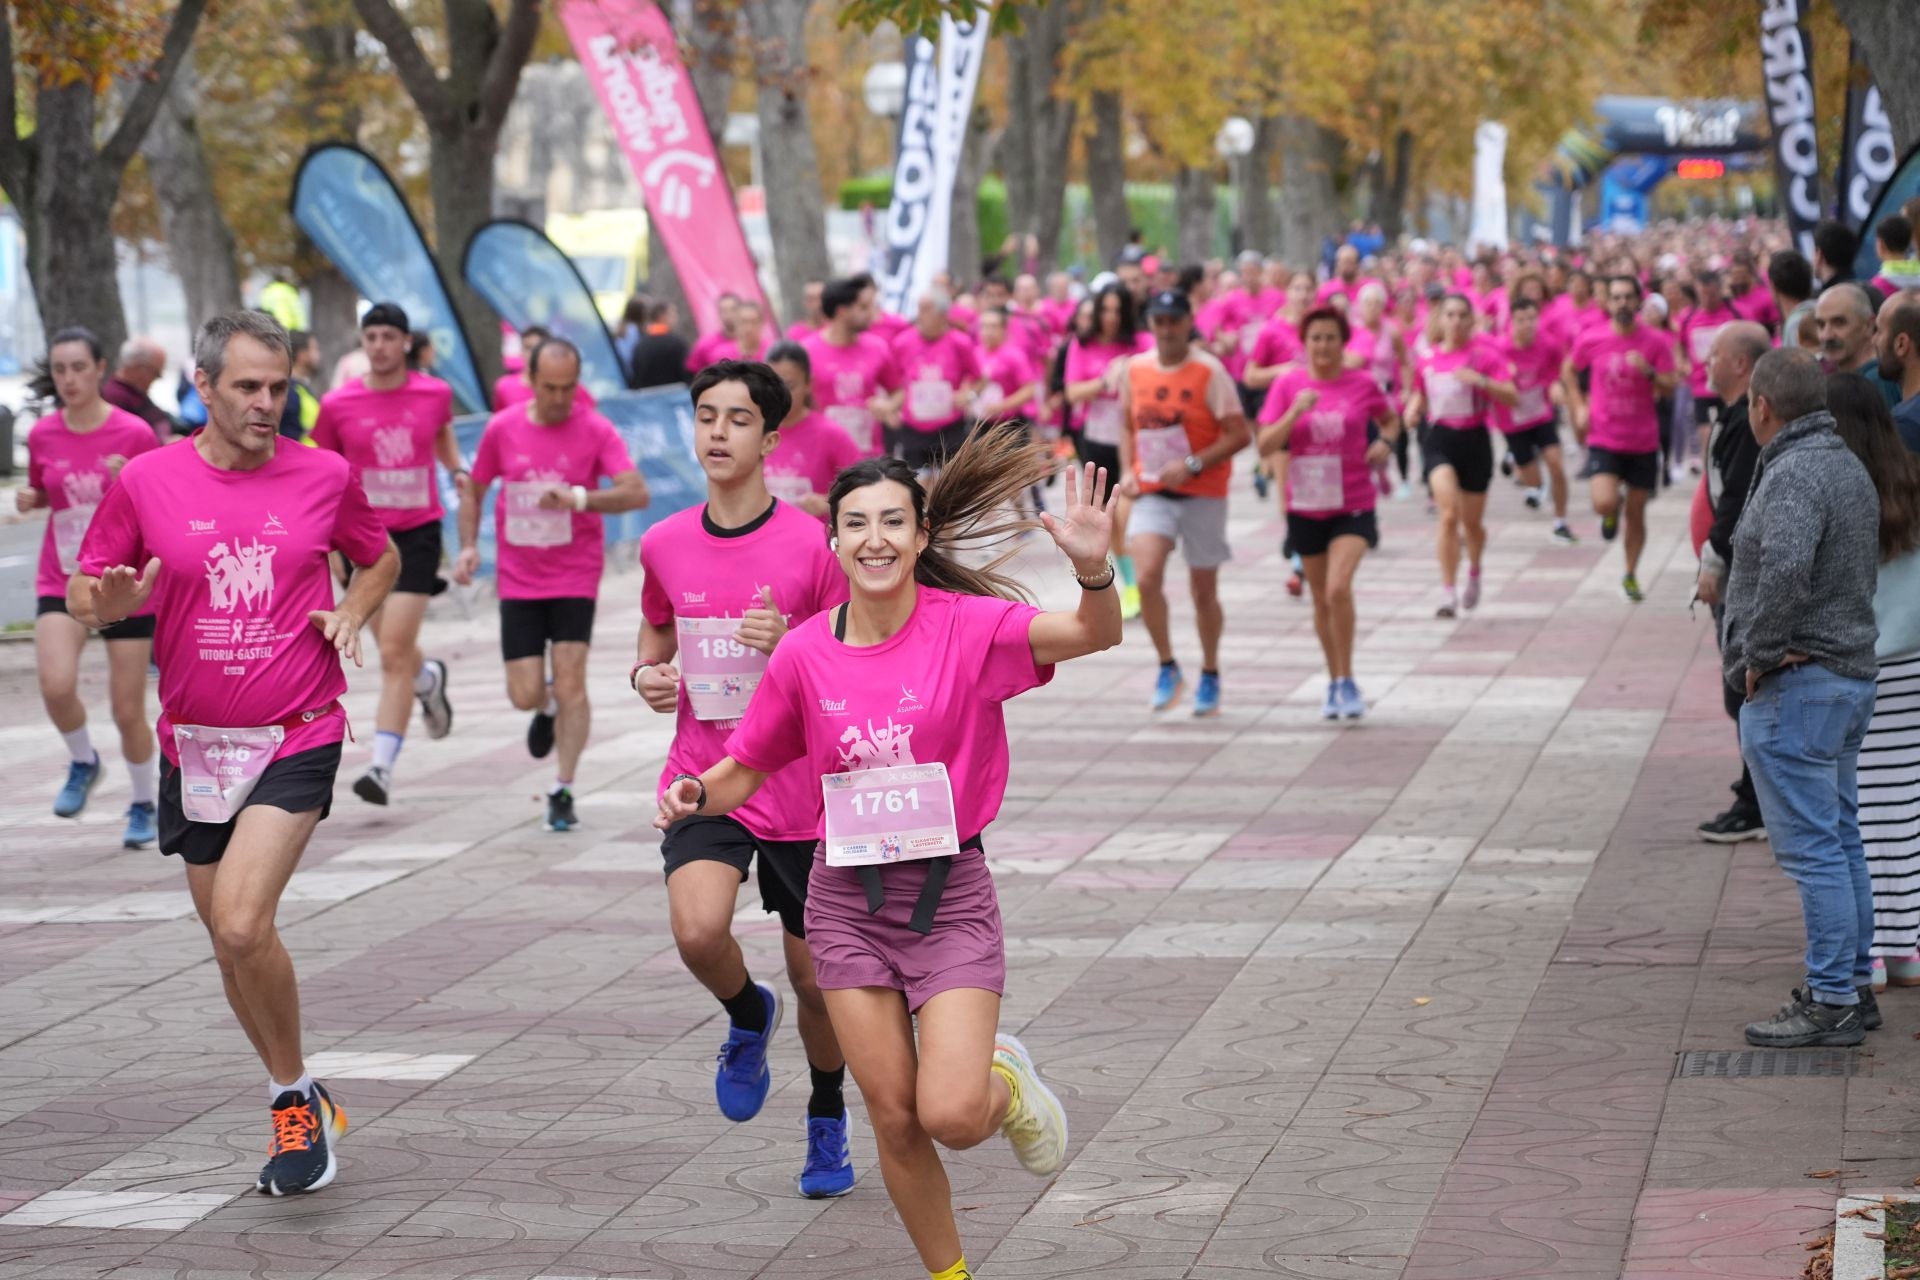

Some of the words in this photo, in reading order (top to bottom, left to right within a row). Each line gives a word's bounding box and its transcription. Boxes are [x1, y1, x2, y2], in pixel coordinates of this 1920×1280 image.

[885, 36, 936, 248] CORR
[188, 519, 216, 531] Vital
[682, 591, 707, 604] Vital
[819, 698, 847, 712] Vital
[896, 704, 925, 714] ASAMMA
[206, 744, 250, 763] 446
[850, 787, 919, 816] 1761
